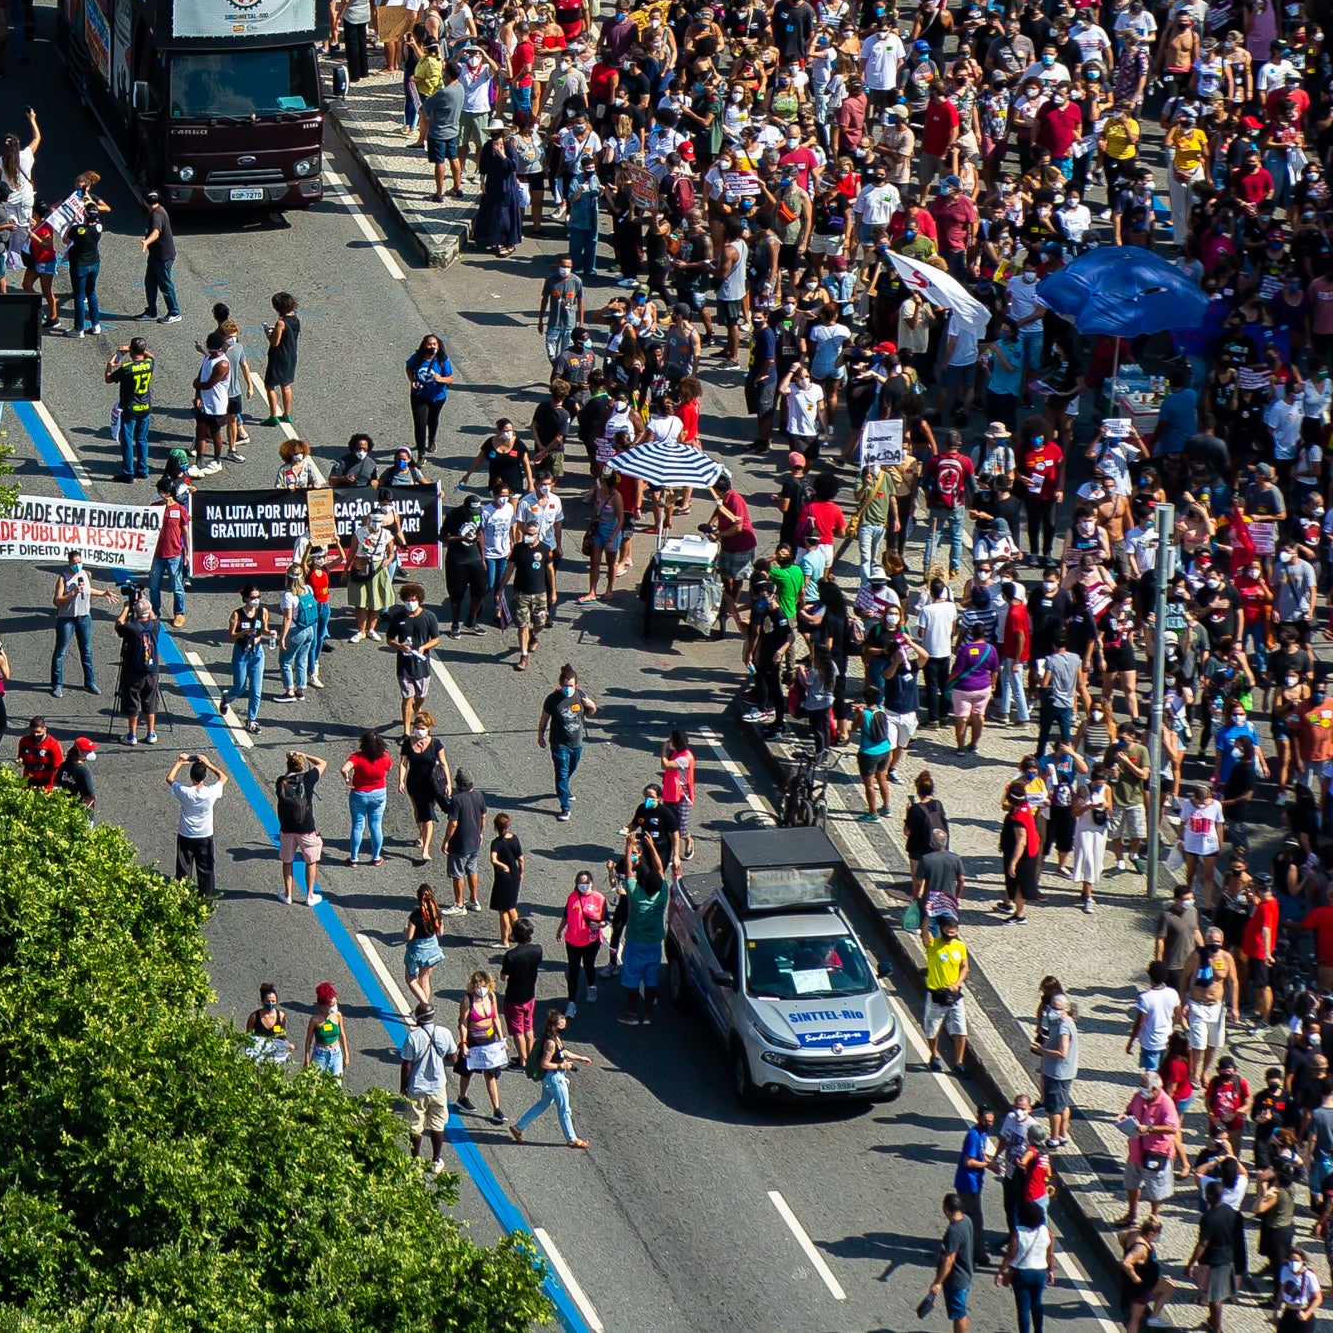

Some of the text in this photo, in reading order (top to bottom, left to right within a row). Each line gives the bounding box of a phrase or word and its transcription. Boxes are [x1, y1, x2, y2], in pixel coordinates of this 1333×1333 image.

[170, 127, 208, 136] CARGO
[55, 507, 160, 533] SEM EDUCAÇÃO
[205, 503, 309, 521] NA LUTA POR UMA
[20, 521, 82, 545] PÚBLICA
[85, 529, 150, 553] RESISTE.
[210, 521, 268, 541] GRATUITA,
[271, 521, 286, 537] DE
[19, 543, 59, 559] DIREITO
[788, 1009, 865, 1024] SINTTEL-Rio
